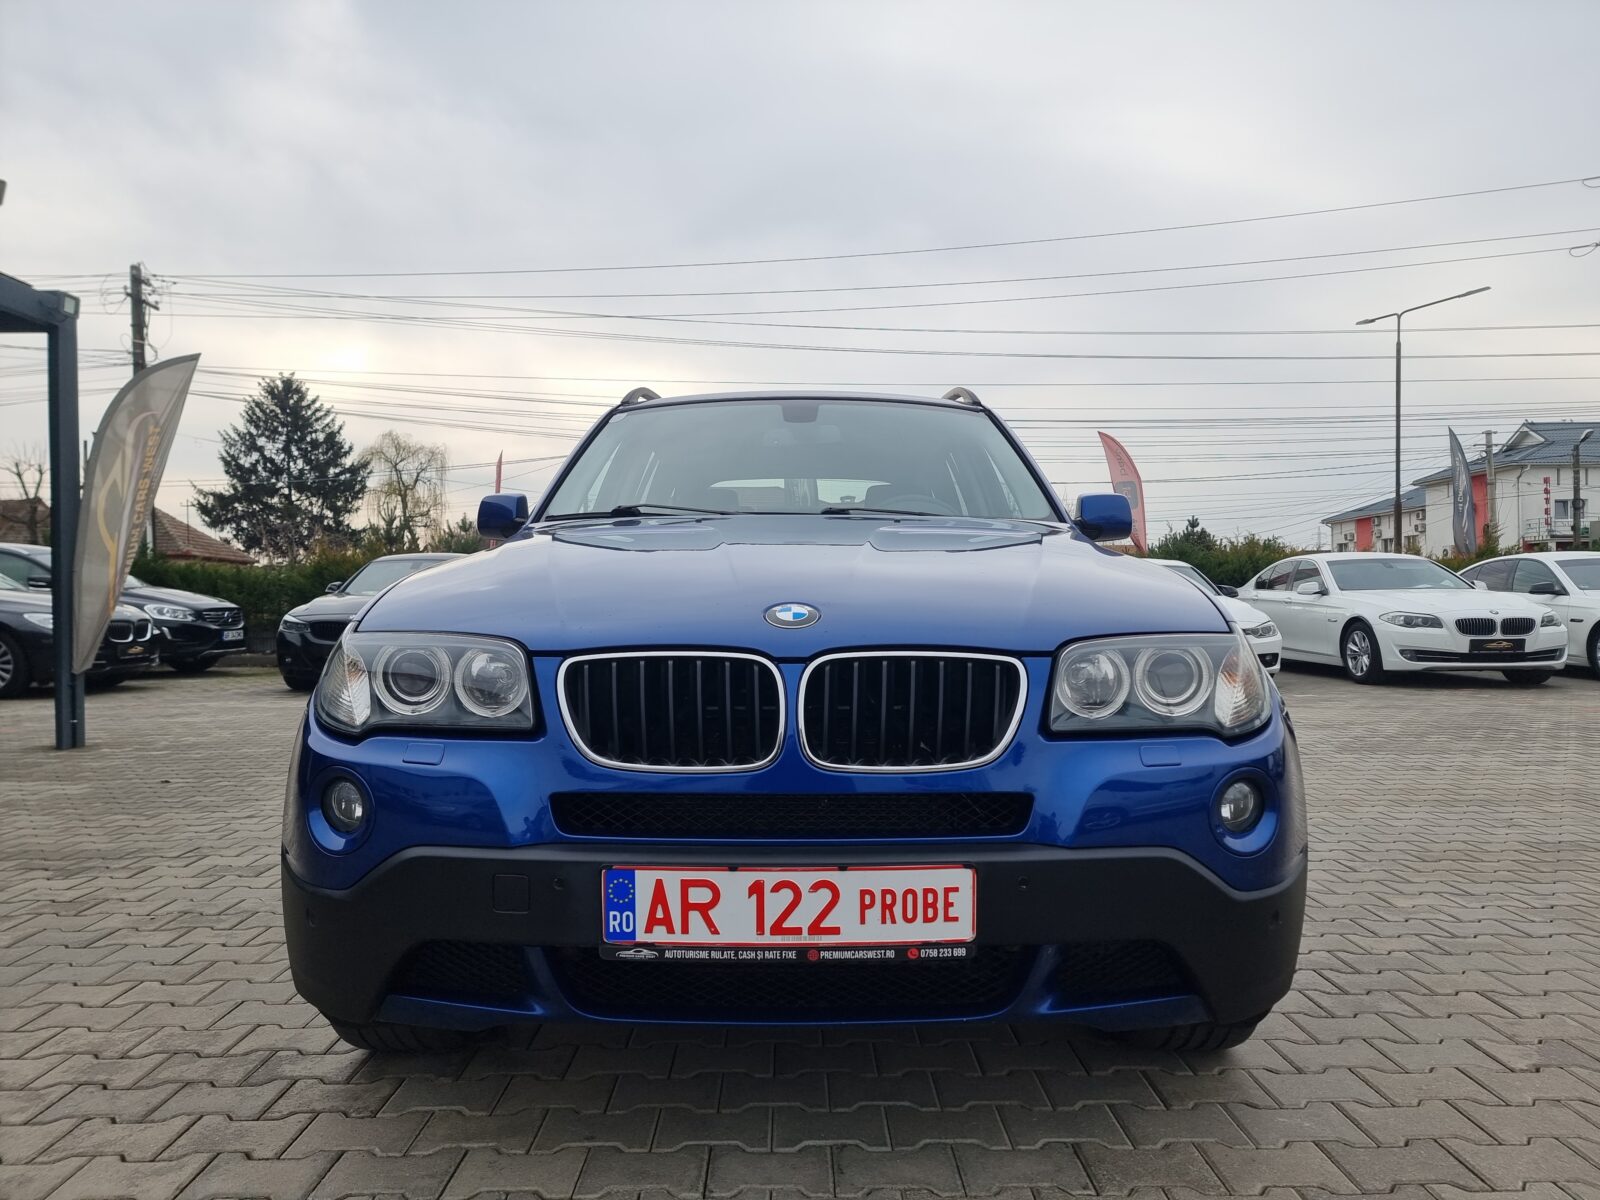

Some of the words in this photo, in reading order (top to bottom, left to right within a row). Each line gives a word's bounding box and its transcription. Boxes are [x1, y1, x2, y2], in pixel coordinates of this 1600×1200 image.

[133, 478, 151, 525] CARS
[143, 425, 161, 472] WEST
[643, 878, 721, 935] AR
[747, 879, 841, 936] 122
[859, 886, 960, 926] PROBE
[608, 910, 634, 933] RO
[664, 949, 711, 959] AUTOTURISME
[711, 950, 737, 960] RULATE,
[738, 950, 756, 960] CASH
[765, 950, 781, 960] RATE
[782, 950, 797, 960] FIXE
[820, 949, 895, 960] PREMIUMCARSWEST.RO
[920, 948, 937, 958] 0758
[938, 948, 952, 957] 233
[952, 947, 967, 957] 699
